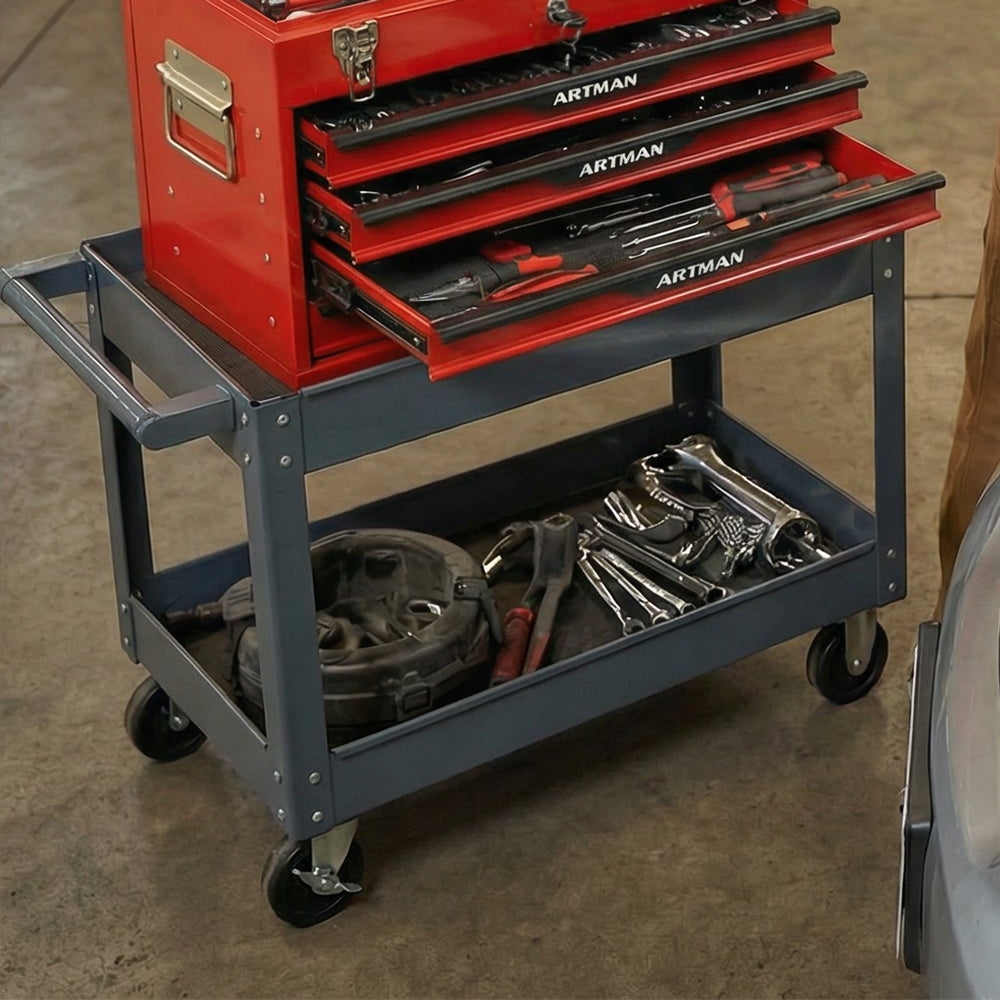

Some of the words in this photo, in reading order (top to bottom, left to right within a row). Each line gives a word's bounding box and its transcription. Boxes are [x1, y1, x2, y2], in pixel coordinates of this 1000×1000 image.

[553, 73, 637, 106] ARTMAN
[579, 141, 664, 178] ARTMAN
[656, 248, 744, 289] ARTMAN
